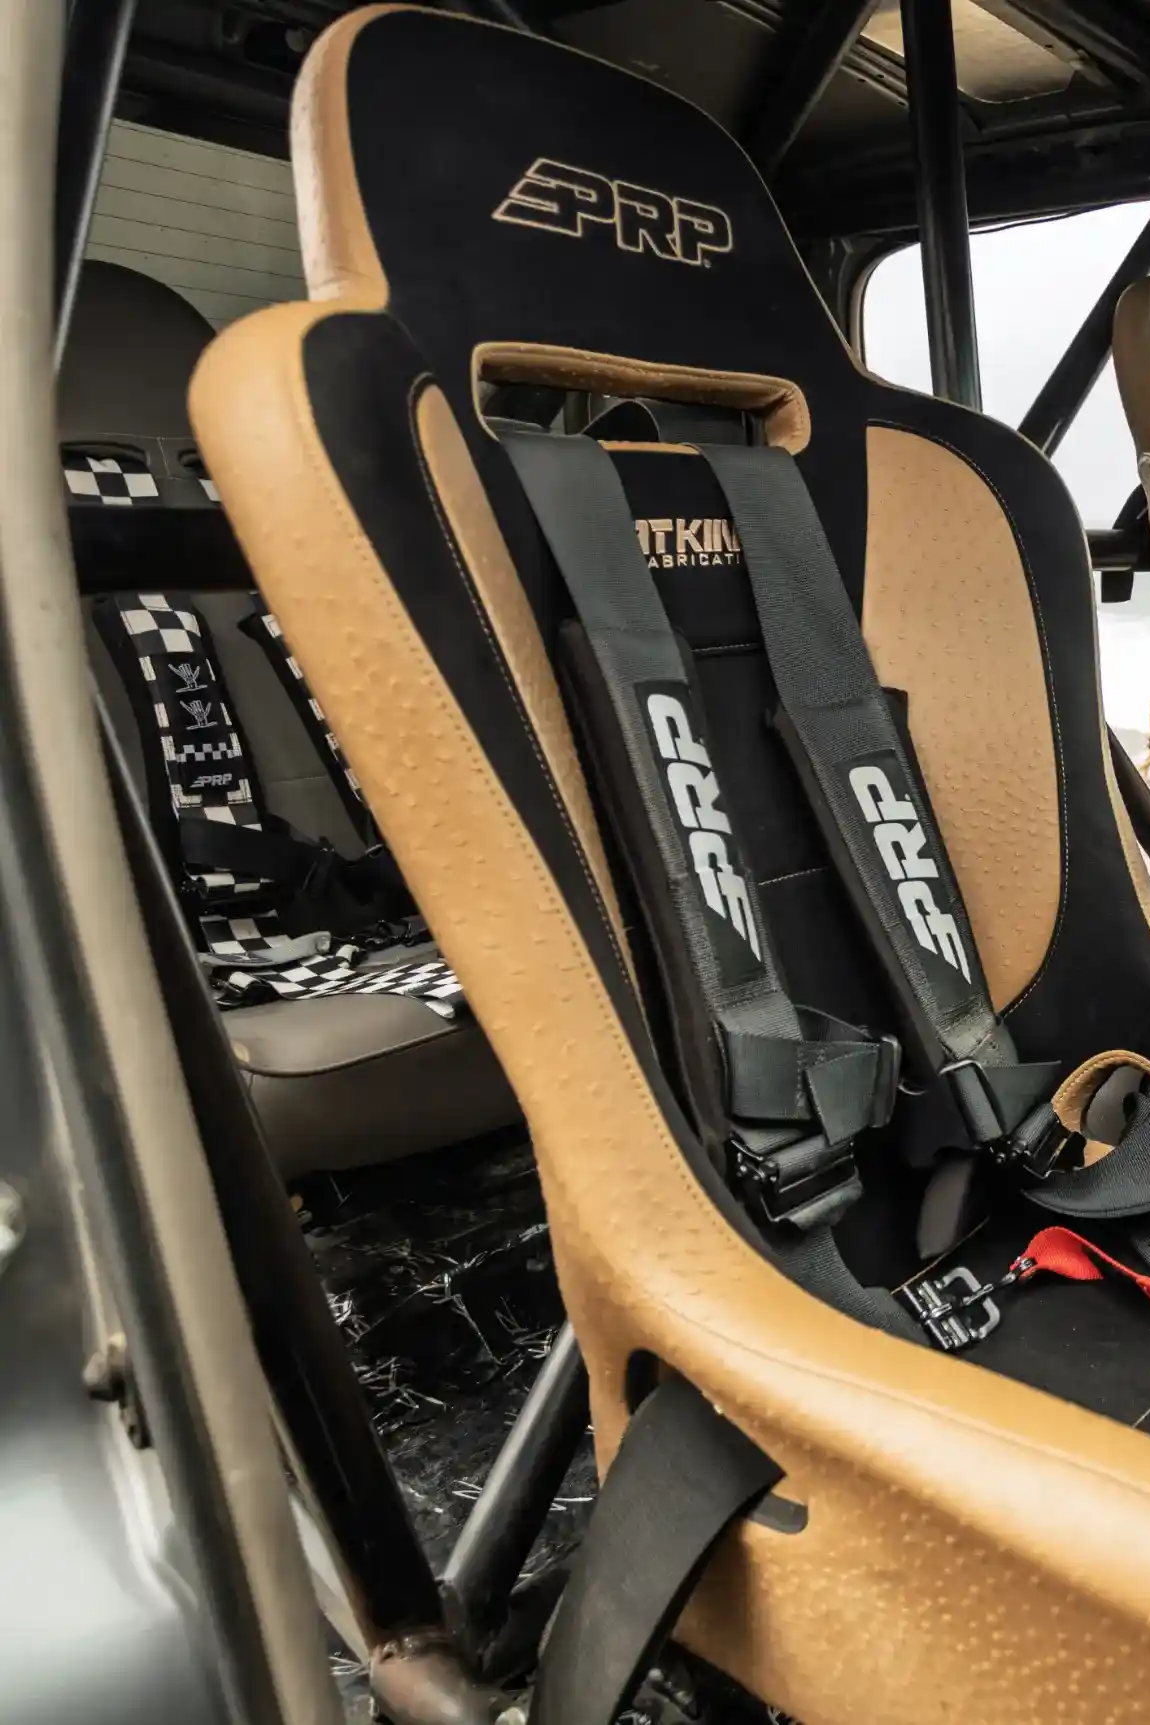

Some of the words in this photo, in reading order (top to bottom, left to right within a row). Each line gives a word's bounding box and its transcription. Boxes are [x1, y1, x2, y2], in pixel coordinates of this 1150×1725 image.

[491, 157, 733, 266] PRP
[646, 693, 762, 963] PRP
[848, 765, 972, 985] PRP
